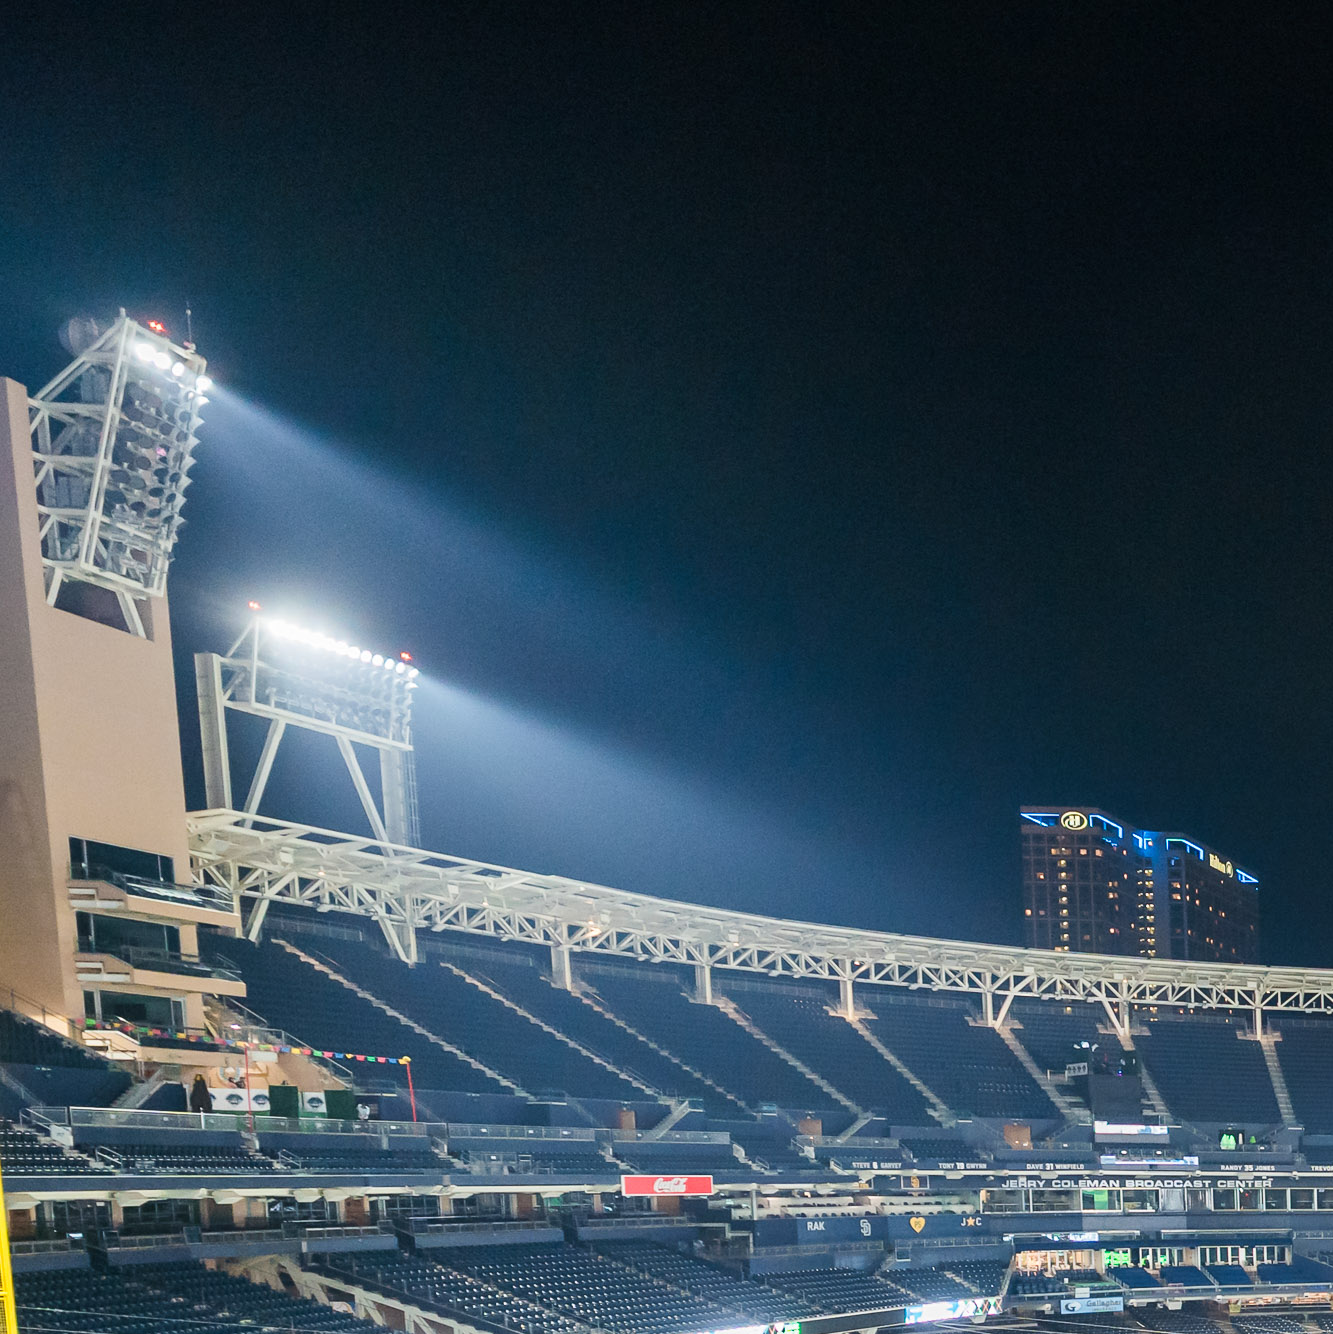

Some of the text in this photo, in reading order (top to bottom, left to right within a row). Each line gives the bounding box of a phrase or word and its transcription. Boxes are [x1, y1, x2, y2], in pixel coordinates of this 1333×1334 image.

[1045, 1162, 1054, 1171] 31
[1001, 1179, 1273, 1188] JERRY COLEMAN BROADCAST CENTER
[807, 1221, 825, 1231] RAK
